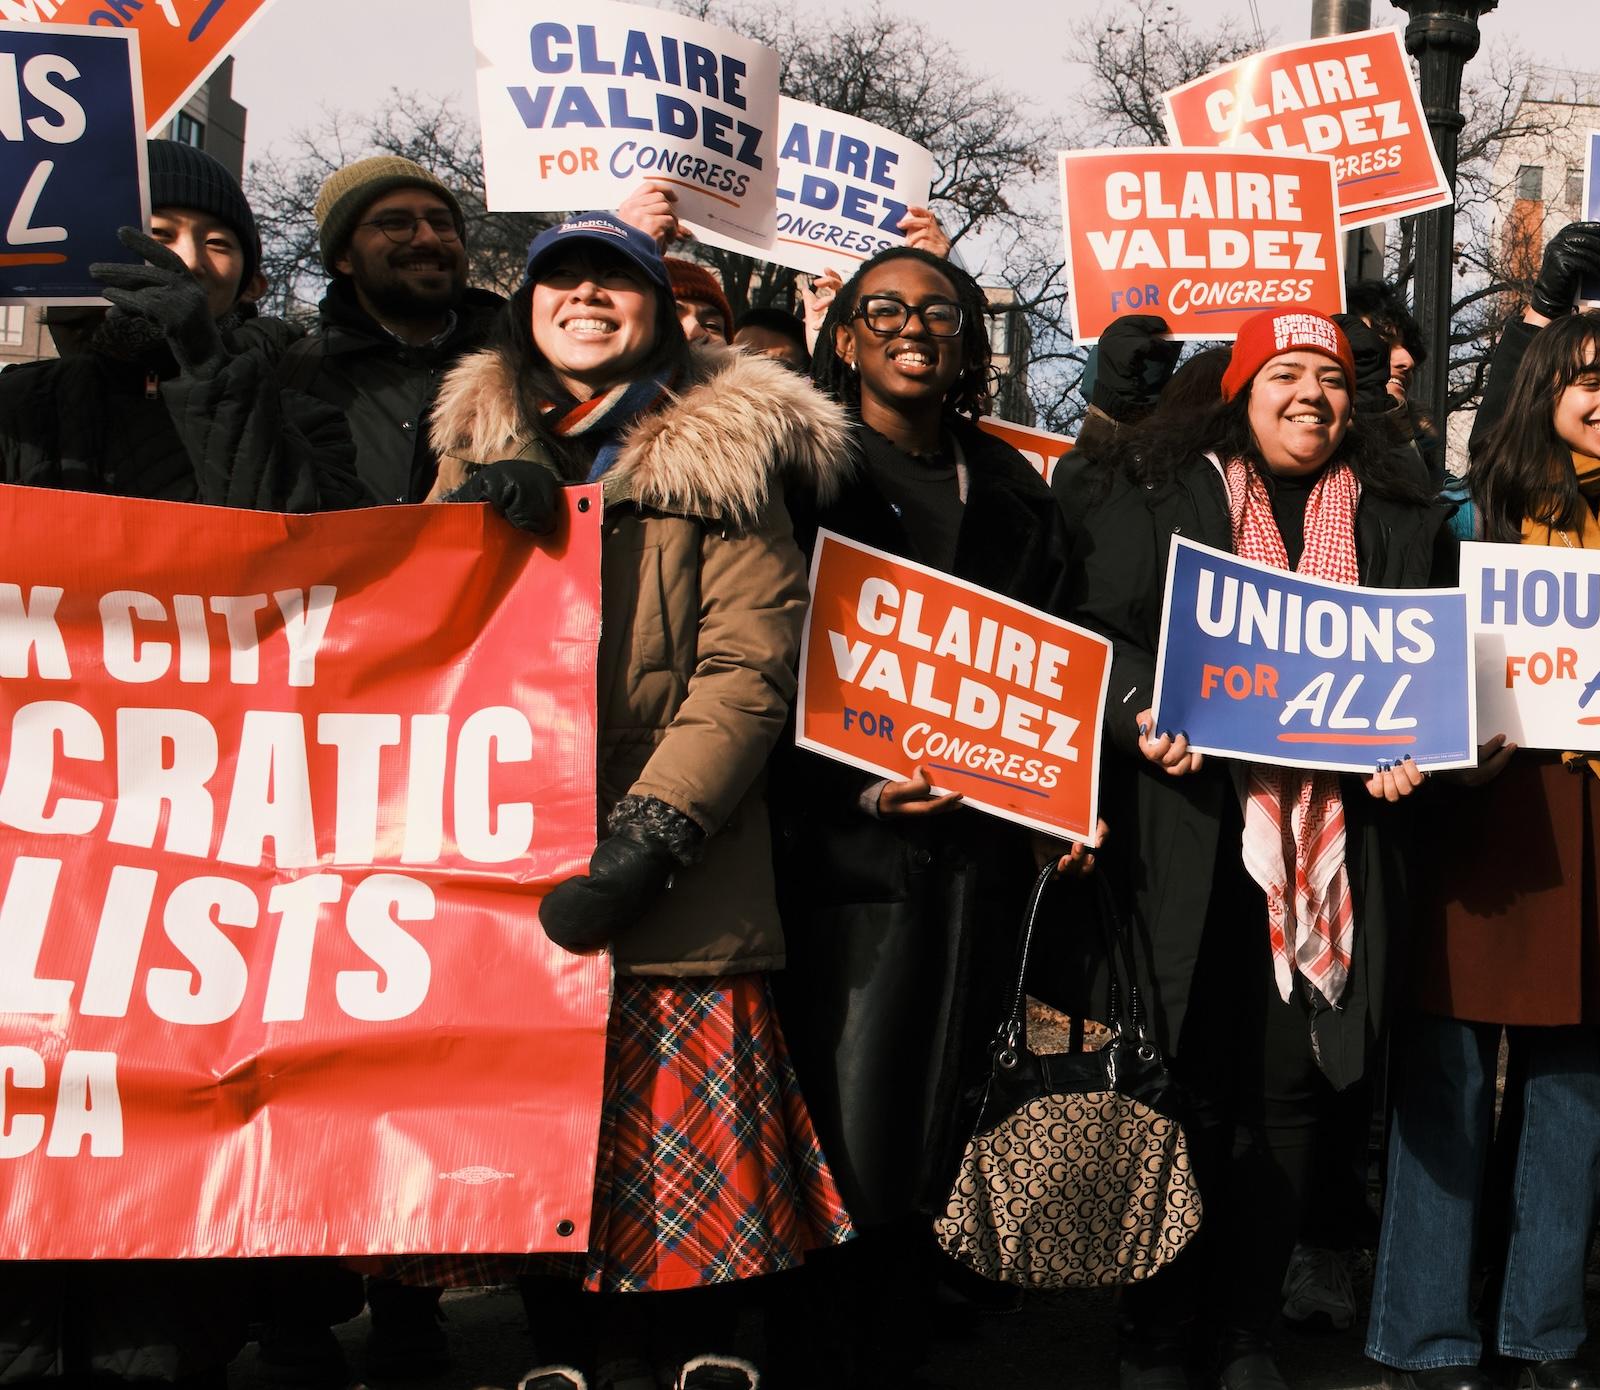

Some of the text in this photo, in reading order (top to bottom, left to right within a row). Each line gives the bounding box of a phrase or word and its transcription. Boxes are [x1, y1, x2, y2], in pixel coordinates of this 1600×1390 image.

[529, 22, 747, 111] CLAIRE
[1205, 53, 1380, 134] CLAIRE
[506, 86, 764, 171] VALDEZ
[779, 122, 899, 190] AIRE
[539, 141, 750, 198] FOR CONGRESS
[1105, 171, 1303, 222] CLAIRE
[1086, 228, 1327, 271] VALDEZ
[1111, 278, 1314, 316] FOR CONGRESS
[1275, 333, 1338, 354] OF AMERICA
[99, 585, 338, 687] CITY
[856, 577, 1070, 701] CLAIRE
[1196, 568, 1436, 664] UNIONS
[828, 629, 1081, 762] VALDEZ
[1201, 663, 1418, 731] FOR ALL
[1505, 646, 1578, 689] FOR
[0, 700, 534, 869] CRATIC
[843, 706, 1062, 788] FOR CONGRESS
[0, 856, 436, 1025] LISTS
